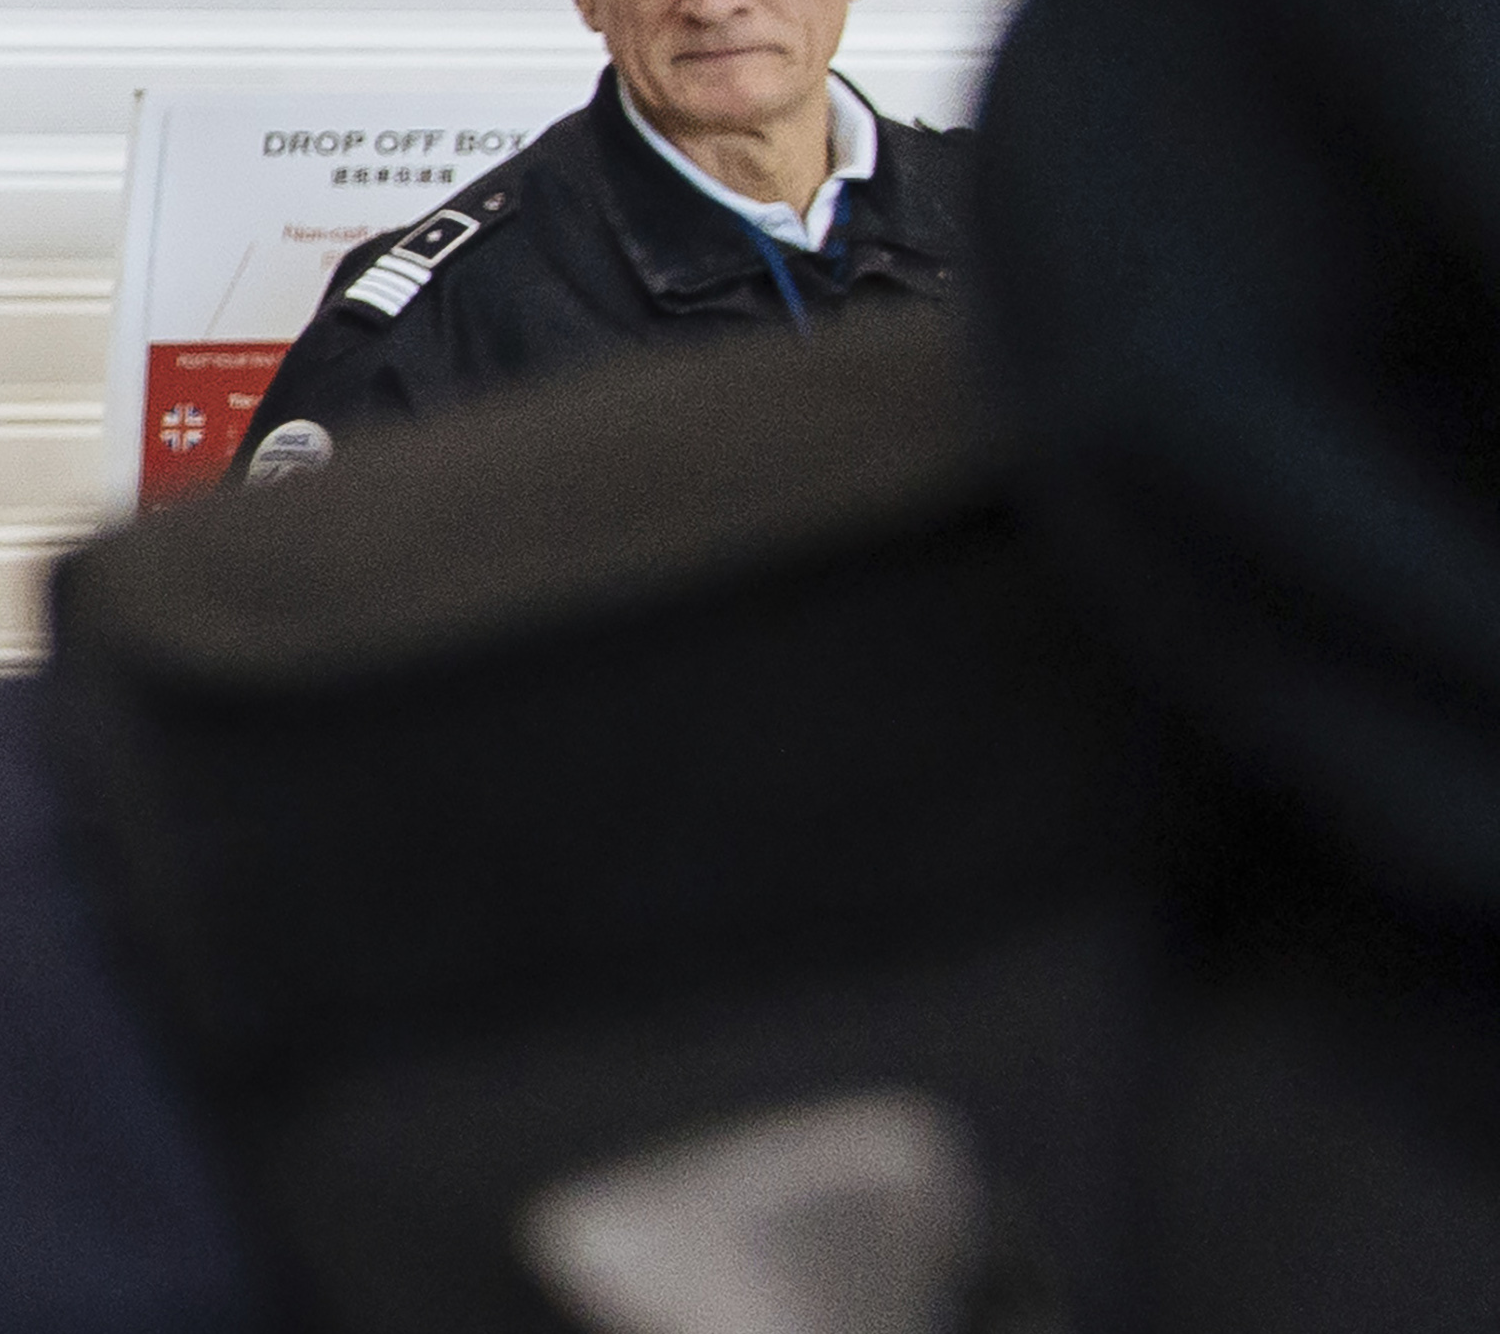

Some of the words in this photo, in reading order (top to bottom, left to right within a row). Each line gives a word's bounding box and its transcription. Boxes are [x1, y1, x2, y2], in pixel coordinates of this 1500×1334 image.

[263, 130, 366, 156] DROP
[374, 129, 446, 155] OFF
[454, 129, 530, 156] BOX
